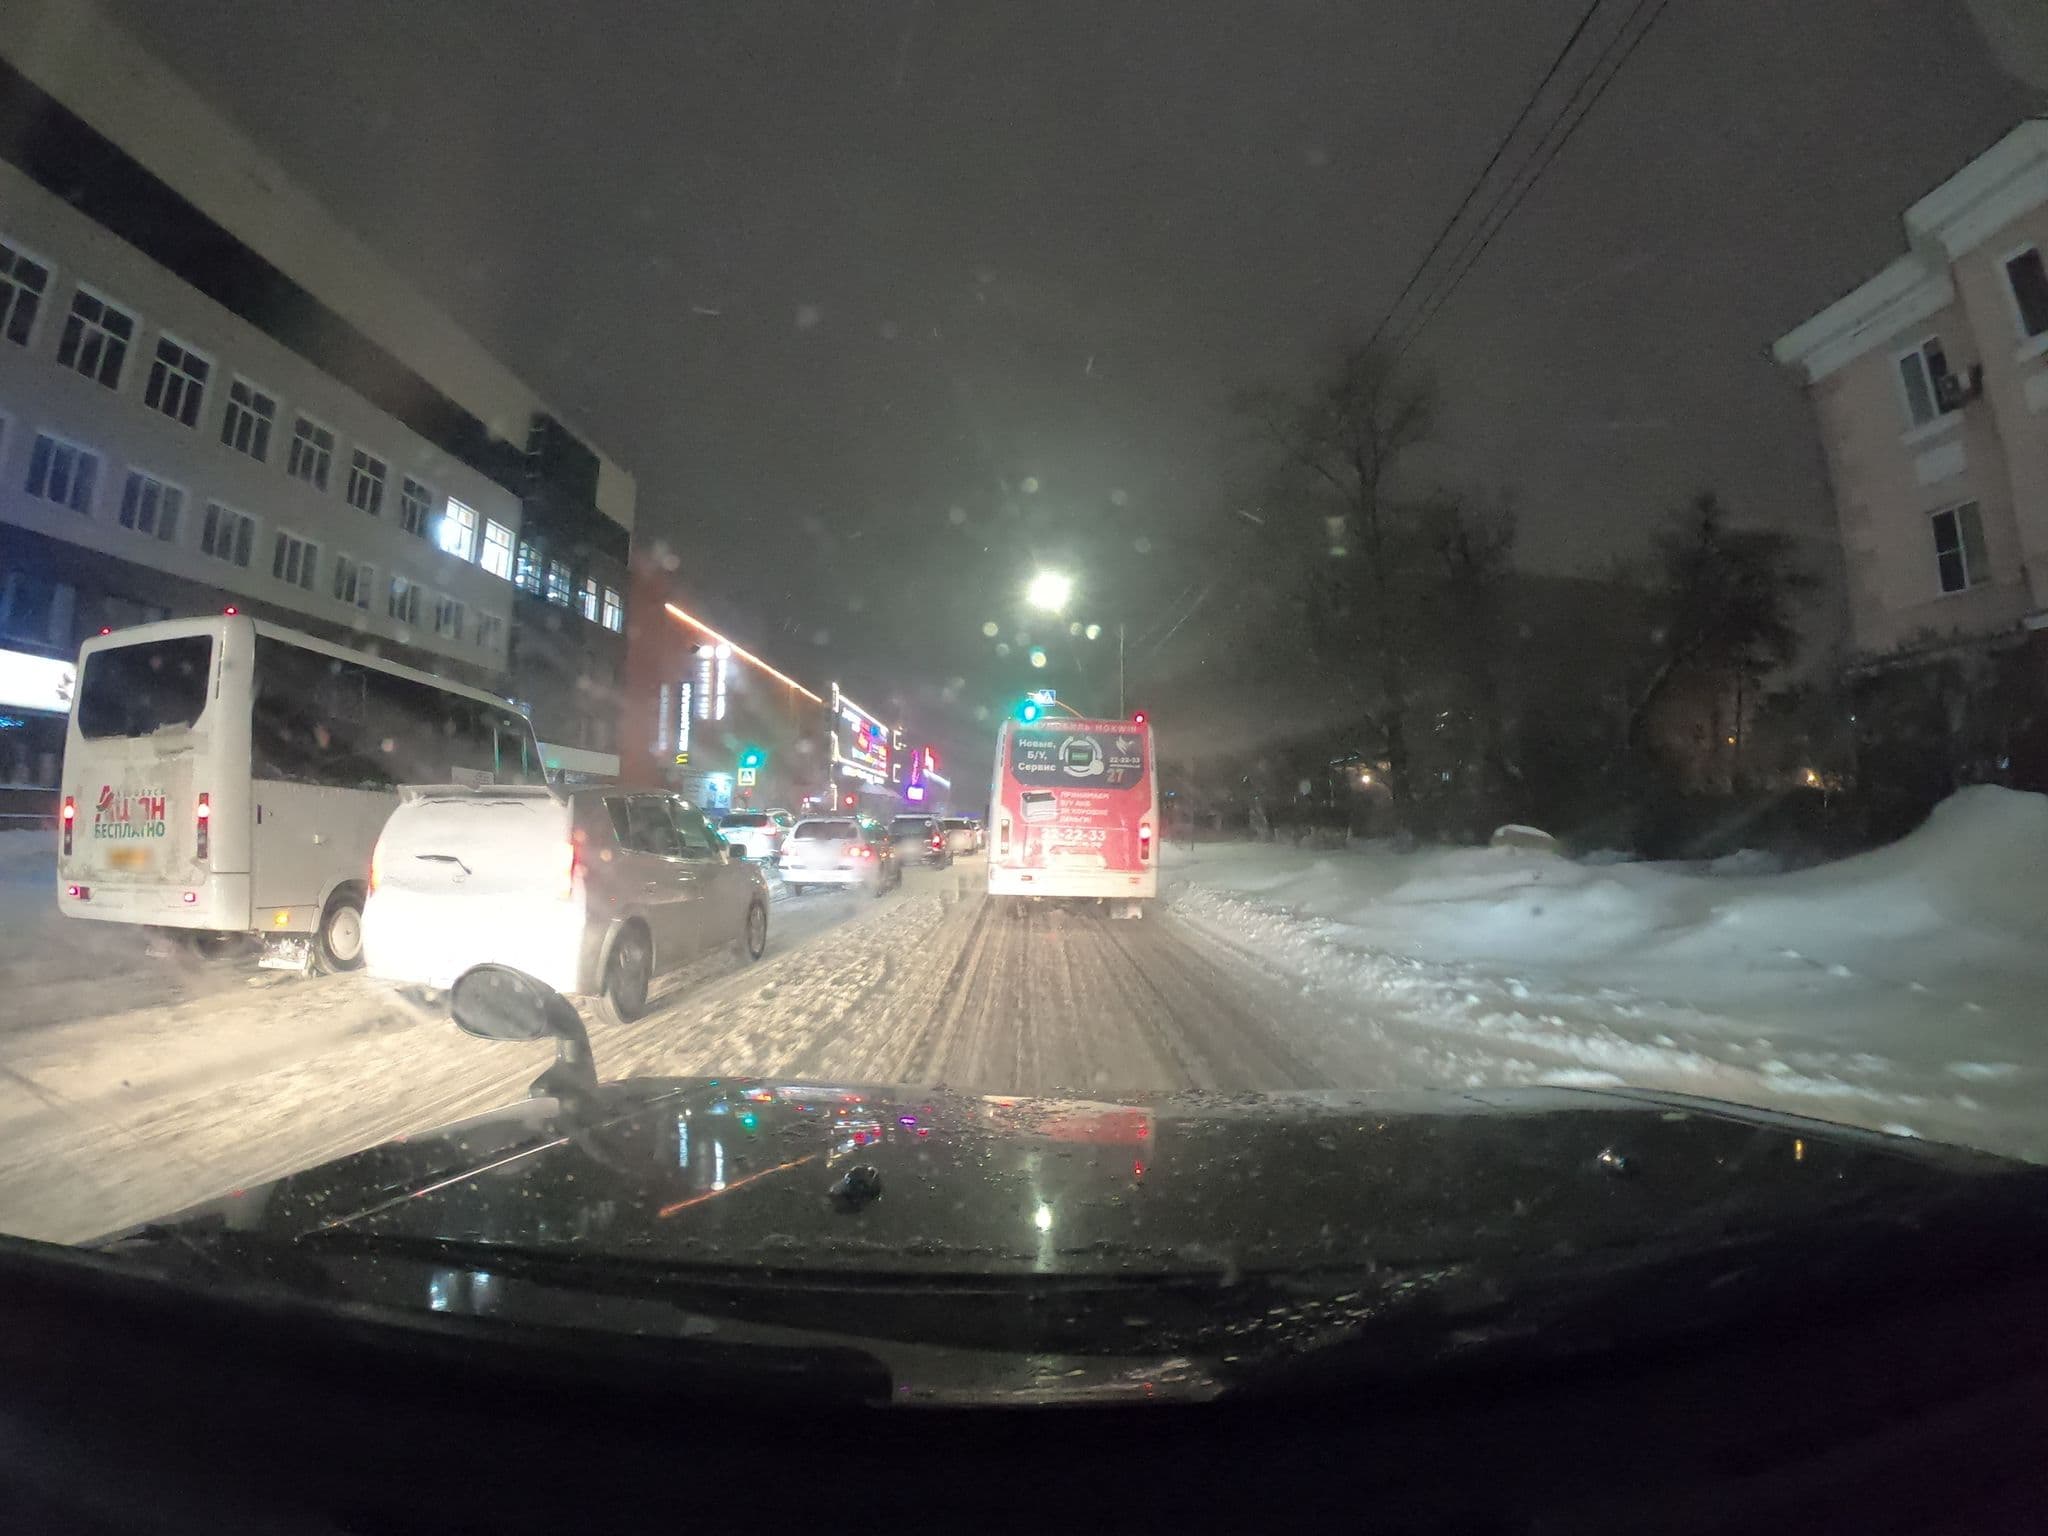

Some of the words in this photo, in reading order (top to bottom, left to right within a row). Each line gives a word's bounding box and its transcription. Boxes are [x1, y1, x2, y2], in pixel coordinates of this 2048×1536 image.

[1018, 739, 1057, 749] Новые,
[1027, 751, 1048, 761] Б/У,
[1018, 763, 1057, 773] Сервис
[1106, 769, 1125, 783] 27
[94, 822, 166, 839] БЕСПЛАТНО
